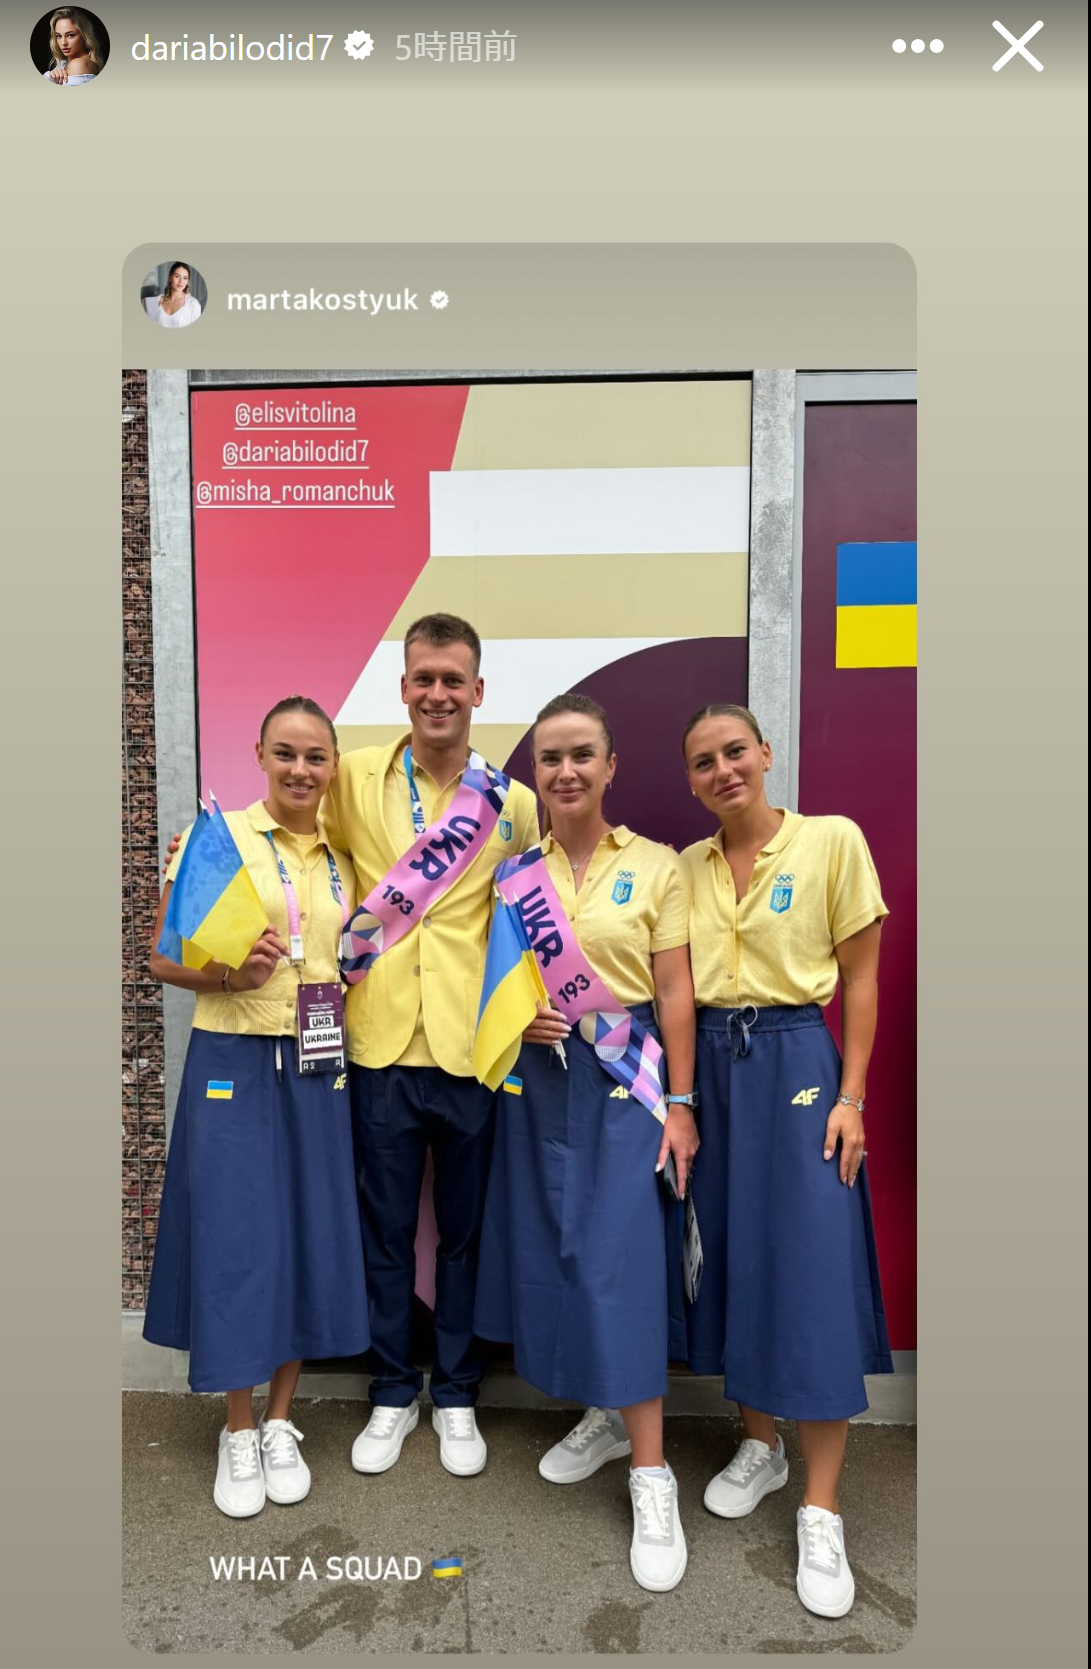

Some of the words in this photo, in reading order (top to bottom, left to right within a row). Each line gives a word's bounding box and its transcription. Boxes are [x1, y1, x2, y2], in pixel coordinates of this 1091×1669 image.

[408, 815, 481, 881] UKR
[382, 884, 415, 916] 193
[519, 885, 564, 968] UKR
[558, 973, 591, 1004] 193
[312, 1017, 331, 1027] UKR
[305, 1032, 340, 1044] UKRAINE
